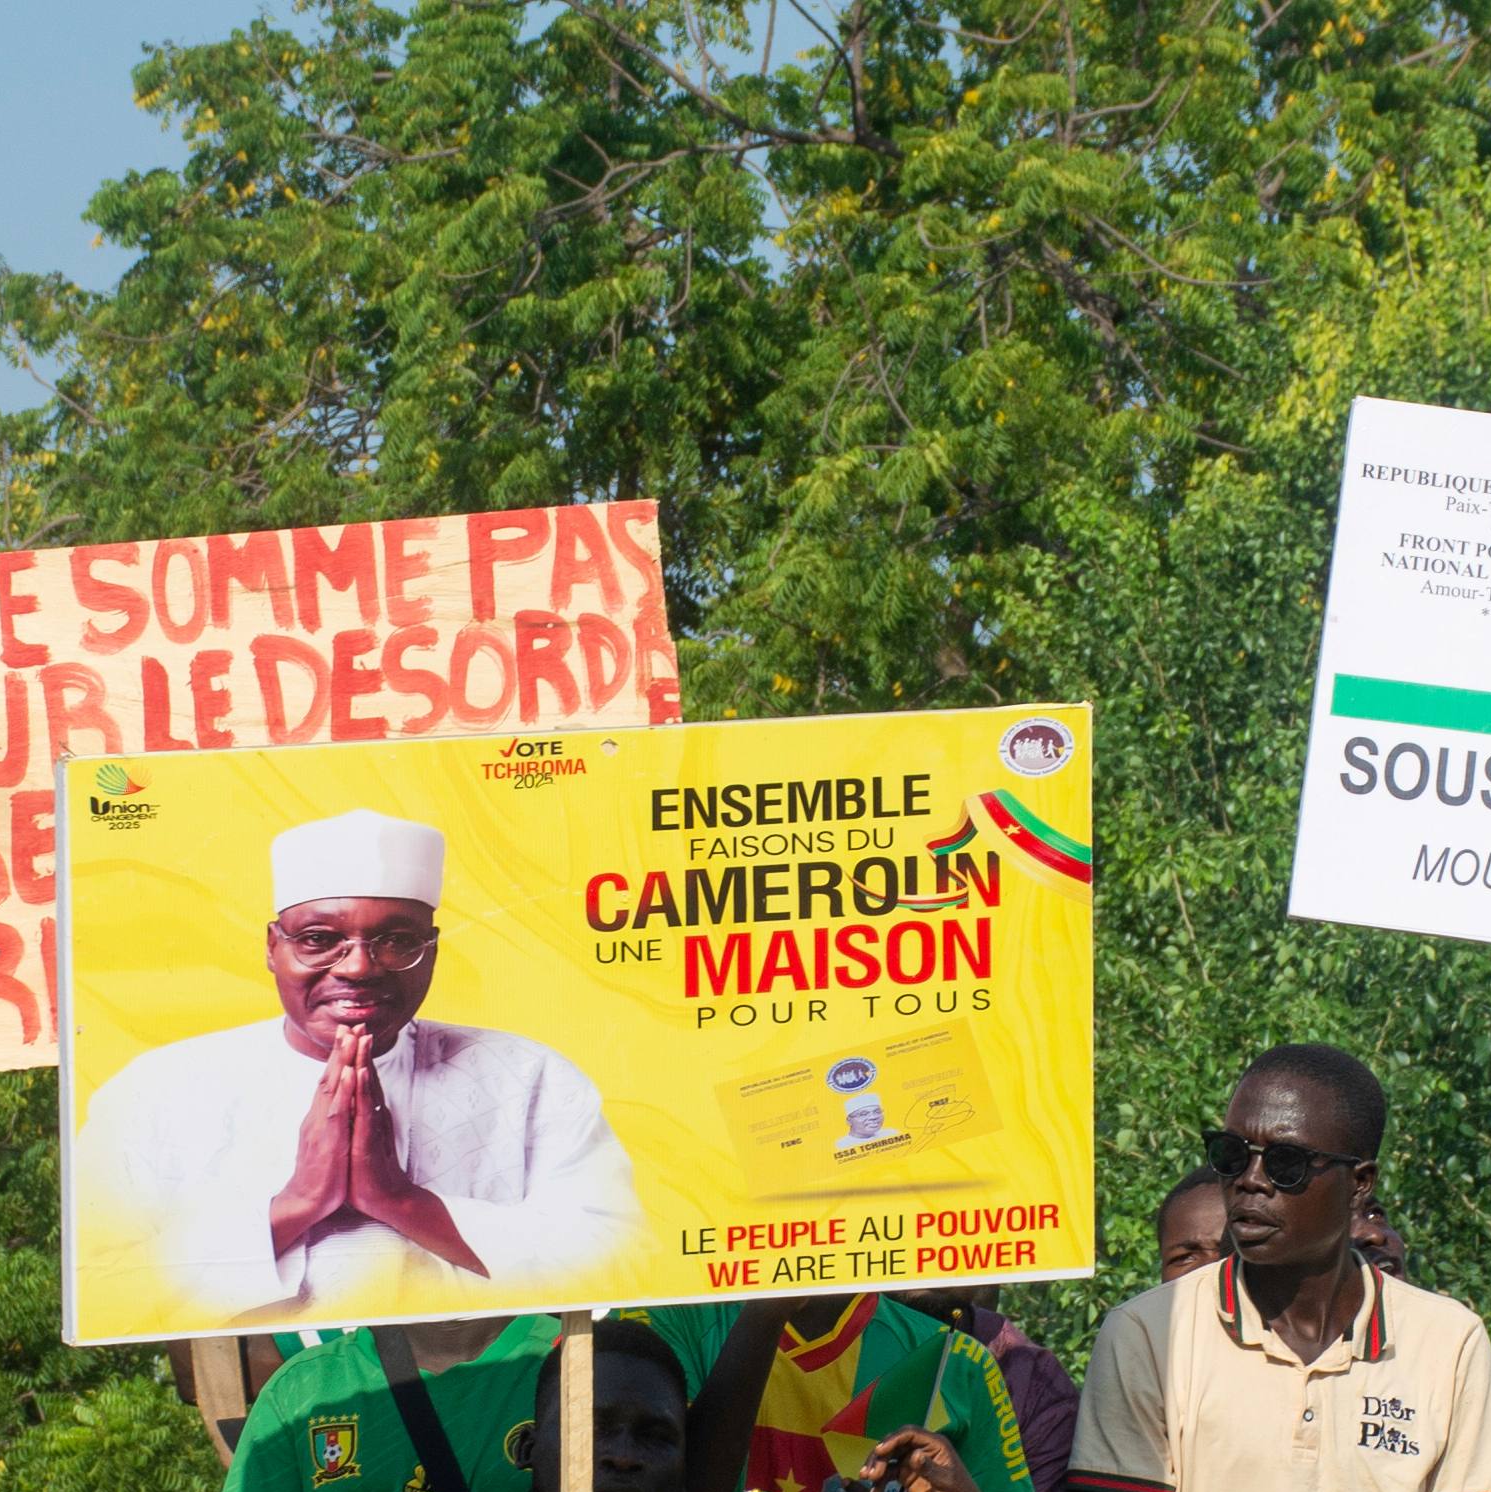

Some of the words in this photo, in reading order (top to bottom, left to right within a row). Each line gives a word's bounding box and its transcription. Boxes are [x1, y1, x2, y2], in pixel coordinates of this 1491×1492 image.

[1398, 532, 1470, 557] FRONT
[68, 517, 432, 655] SOMME
[464, 501, 665, 624] PAS
[1380, 552, 1488, 580] NATIONAL
[142, 648, 233, 752] LE
[481, 758, 587, 780] TCHIROMA
[89, 796, 151, 816] Union
[650, 773, 932, 832] ENSEMBLE
[108, 821, 141, 831] 2025
[689, 830, 836, 861] FAISONS
[847, 826, 895, 852] DU
[584, 850, 1001, 933] CAMEROUN
[594, 938, 663, 965] UNE
[683, 917, 993, 999] MAISON
[696, 999, 828, 1030] POUR
[863, 988, 992, 1019] TOUS
[833, 1146, 857, 1161] ISSA
[859, 1132, 912, 1153] TCHIROMA
[681, 1227, 717, 1255] LE
[726, 1218, 847, 1252] PEUPLE
[858, 1214, 905, 1244] AU
[915, 1203, 1061, 1239] POUVOIR
[707, 1259, 760, 1289] WE
[771, 1253, 836, 1284] ARE
[845, 1249, 907, 1279] THE
[916, 1239, 1037, 1274] POWER
